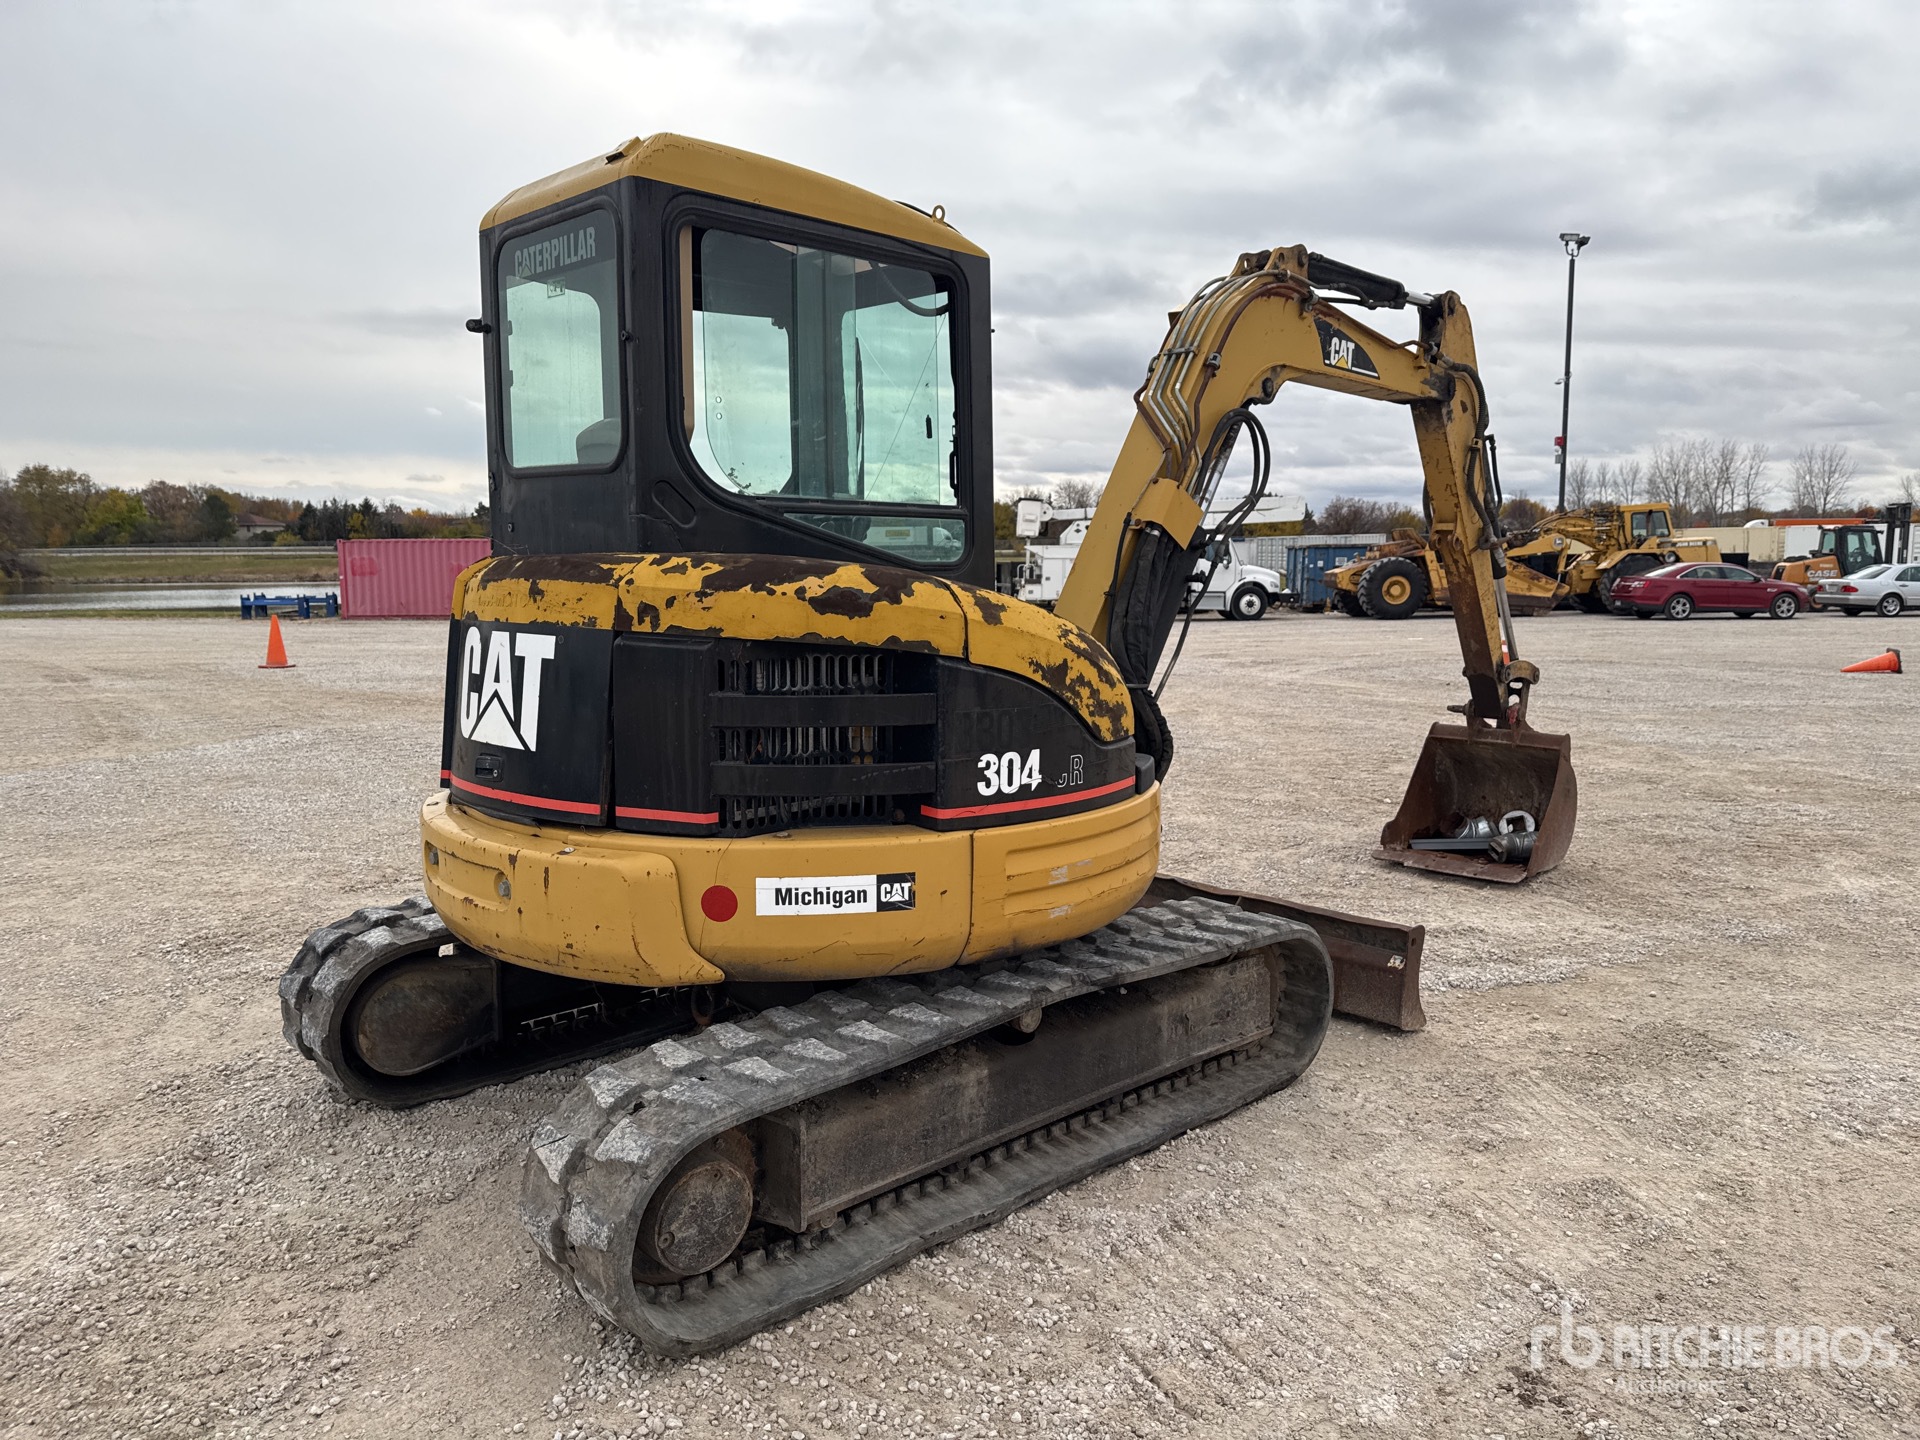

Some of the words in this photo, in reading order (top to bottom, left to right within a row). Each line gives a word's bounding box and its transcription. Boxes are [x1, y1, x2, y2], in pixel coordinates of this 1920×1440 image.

[515, 227, 596, 279] CATERPILLAR
[1330, 336, 1355, 370] CAT
[1807, 569, 1839, 578] CASE
[460, 626, 557, 752] CAT
[977, 748, 1042, 796] 304
[774, 886, 868, 909] Michigan
[880, 882, 912, 903] CAT
